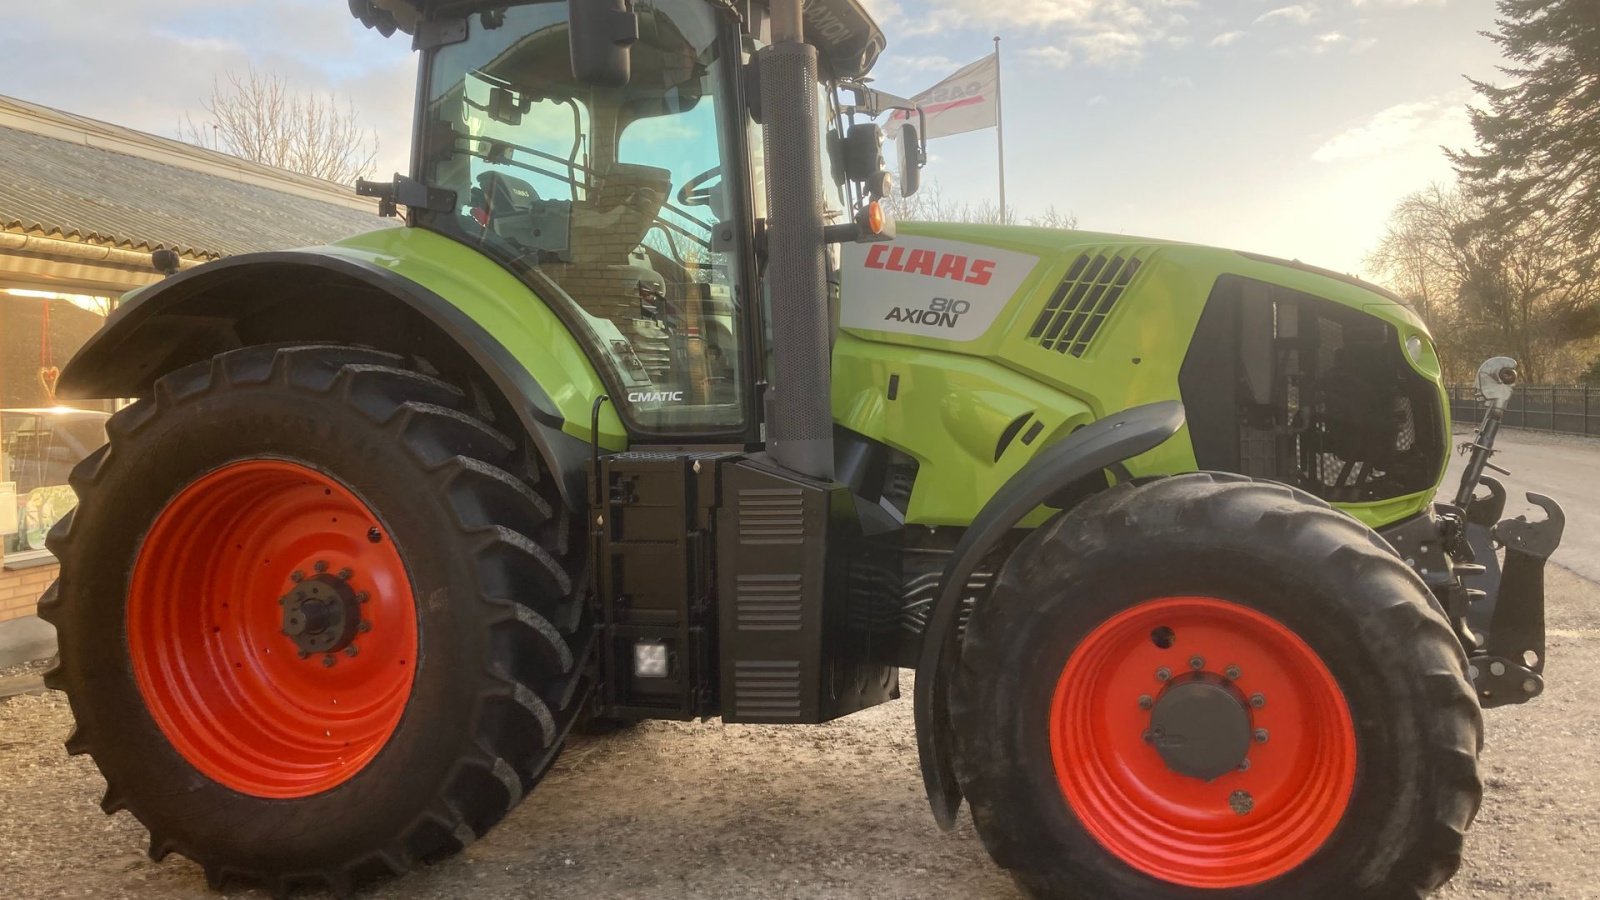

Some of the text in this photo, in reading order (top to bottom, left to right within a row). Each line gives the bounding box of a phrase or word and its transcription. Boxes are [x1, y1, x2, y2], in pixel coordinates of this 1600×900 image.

[807, 5, 854, 45] AXION
[864, 244, 996, 286] CLAAS
[885, 306, 959, 328] AXION
[929, 297, 970, 315] 810
[627, 391, 683, 402] CMATIC
